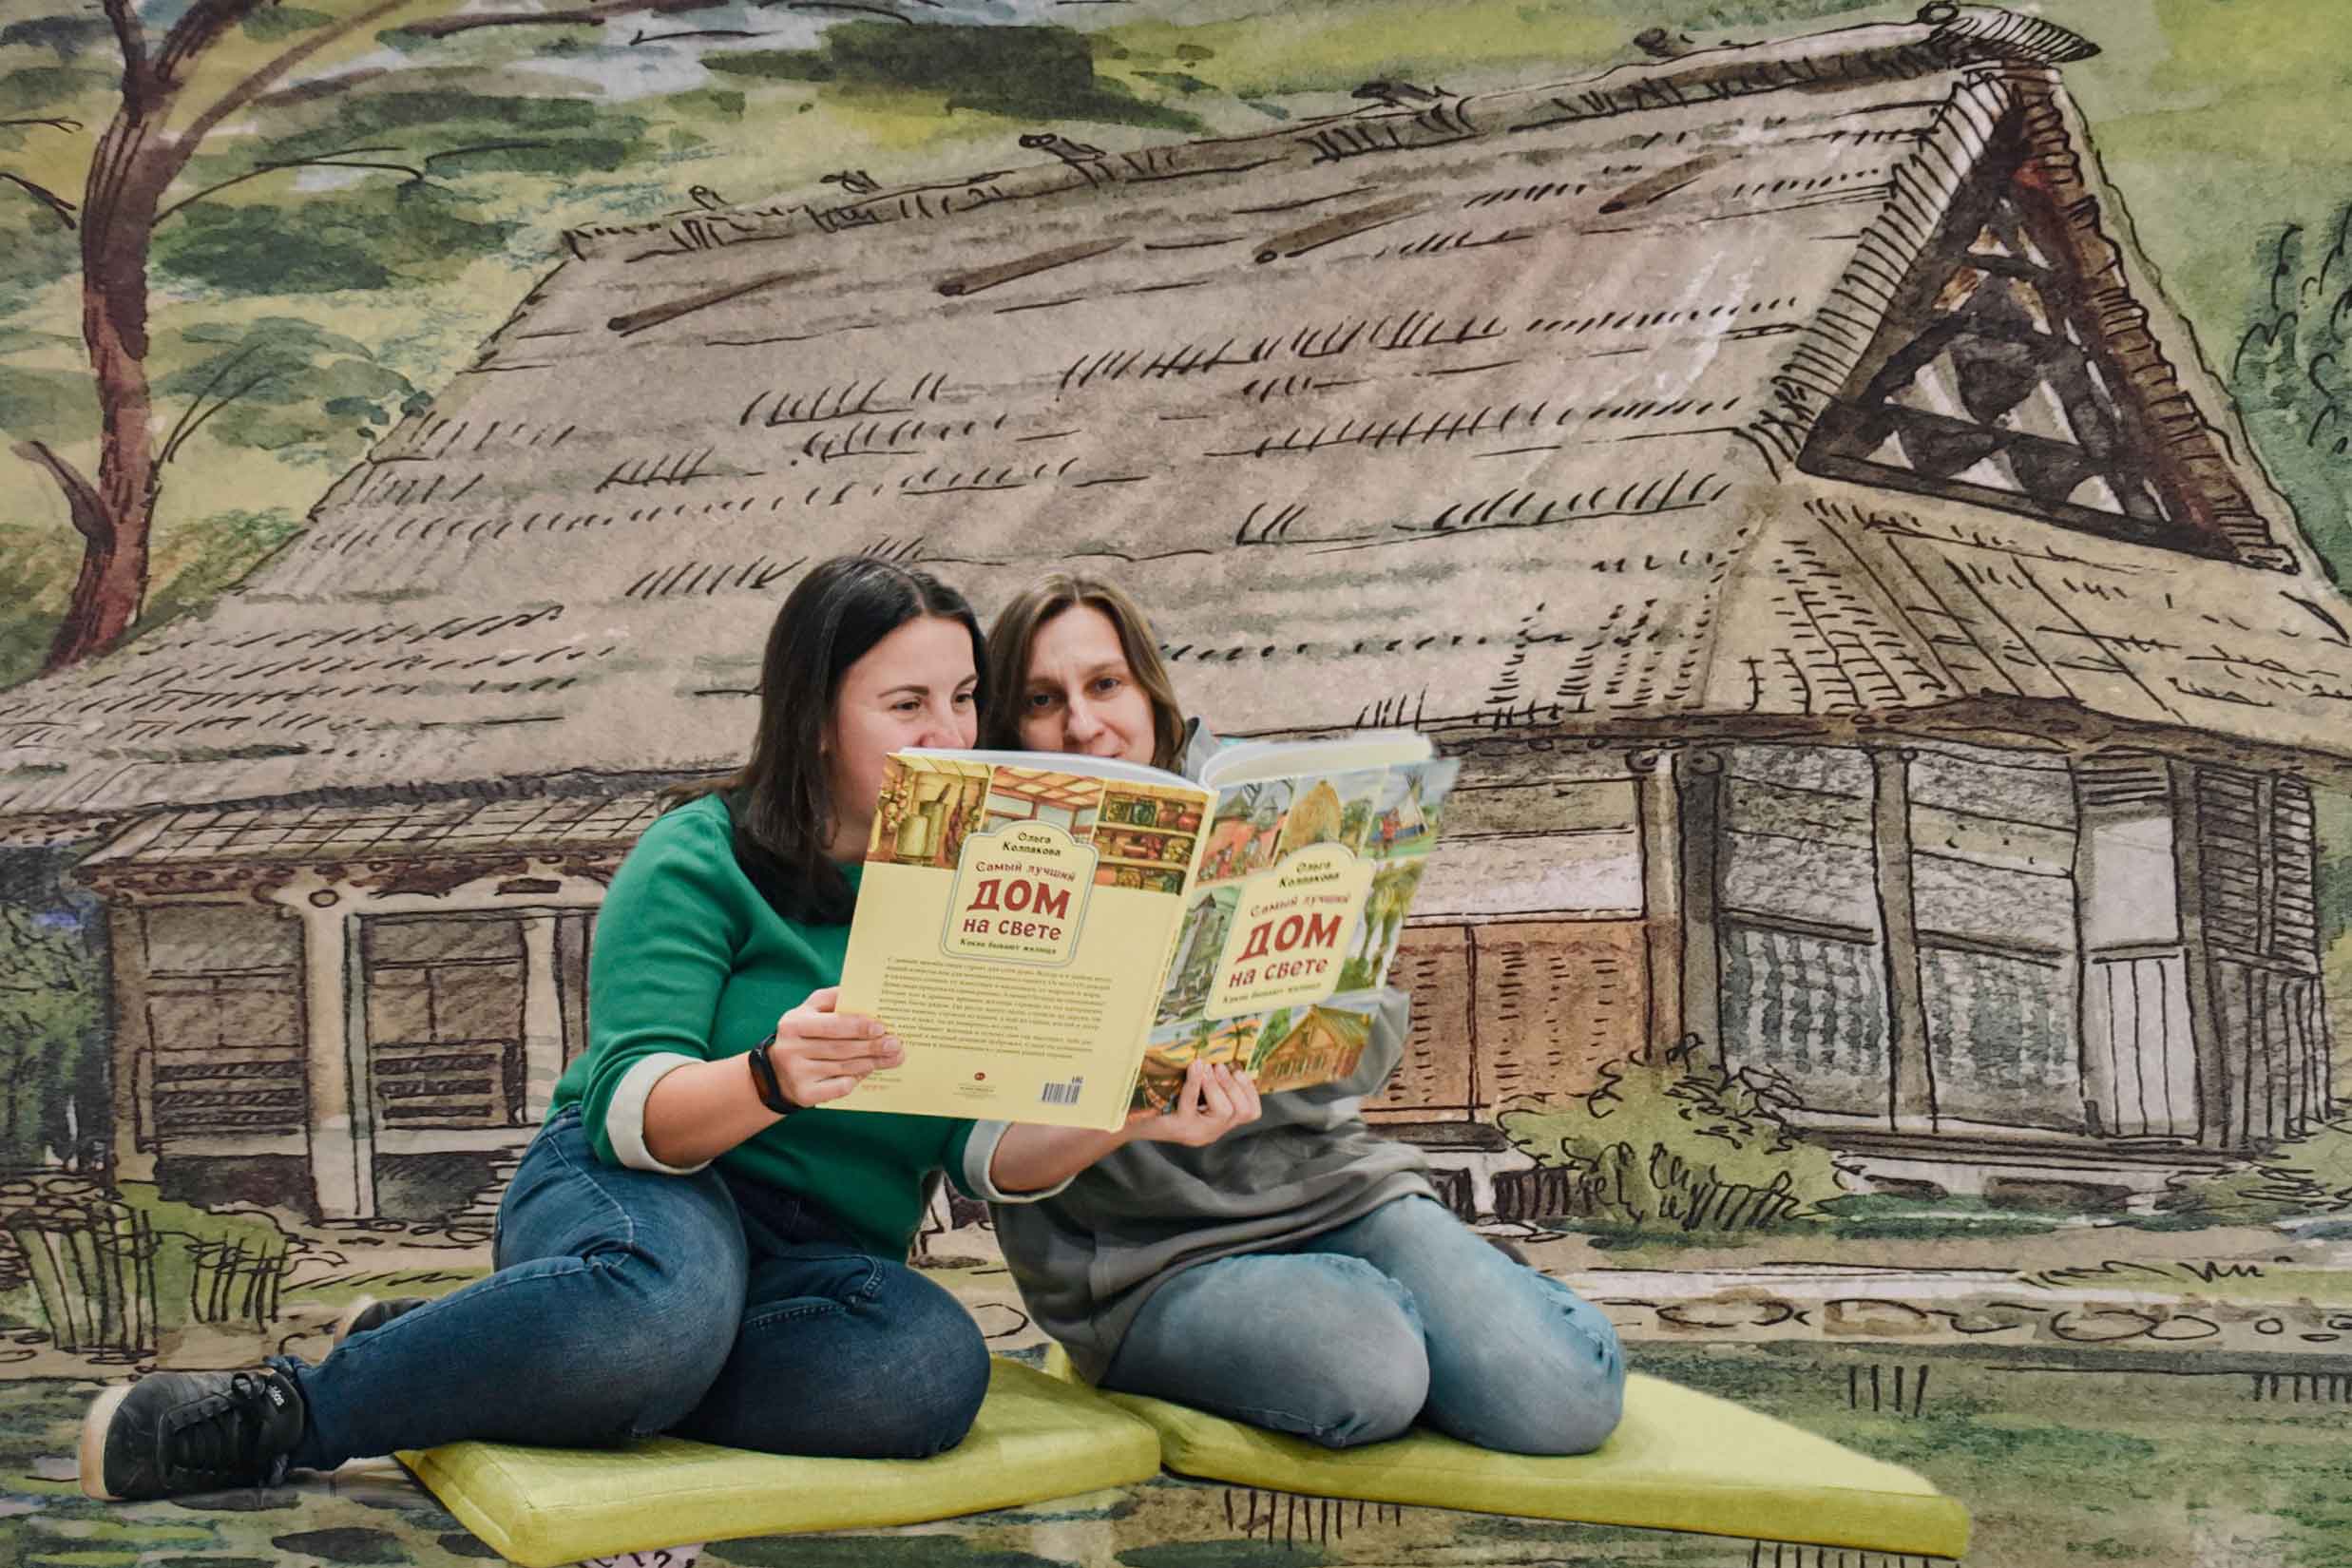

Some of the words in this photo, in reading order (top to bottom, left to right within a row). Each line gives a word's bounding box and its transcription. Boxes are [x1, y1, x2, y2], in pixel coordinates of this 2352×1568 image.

[1003, 841, 1061, 856] Колпакова
[1018, 832, 1051, 844] Ольга
[975, 861, 1023, 872] Самый
[1028, 864, 1076, 882] лучший
[1296, 861, 1331, 872] Ольга
[1279, 872, 1340, 888] Колпакова
[966, 878, 1071, 920] ДОМ
[1250, 895, 1298, 917] Самый
[963, 918, 990, 933] на
[998, 919, 1062, 941] свете
[1235, 912, 1343, 964] ДОМ
[1229, 967, 1256, 988] на
[1264, 957, 1329, 981] свете
